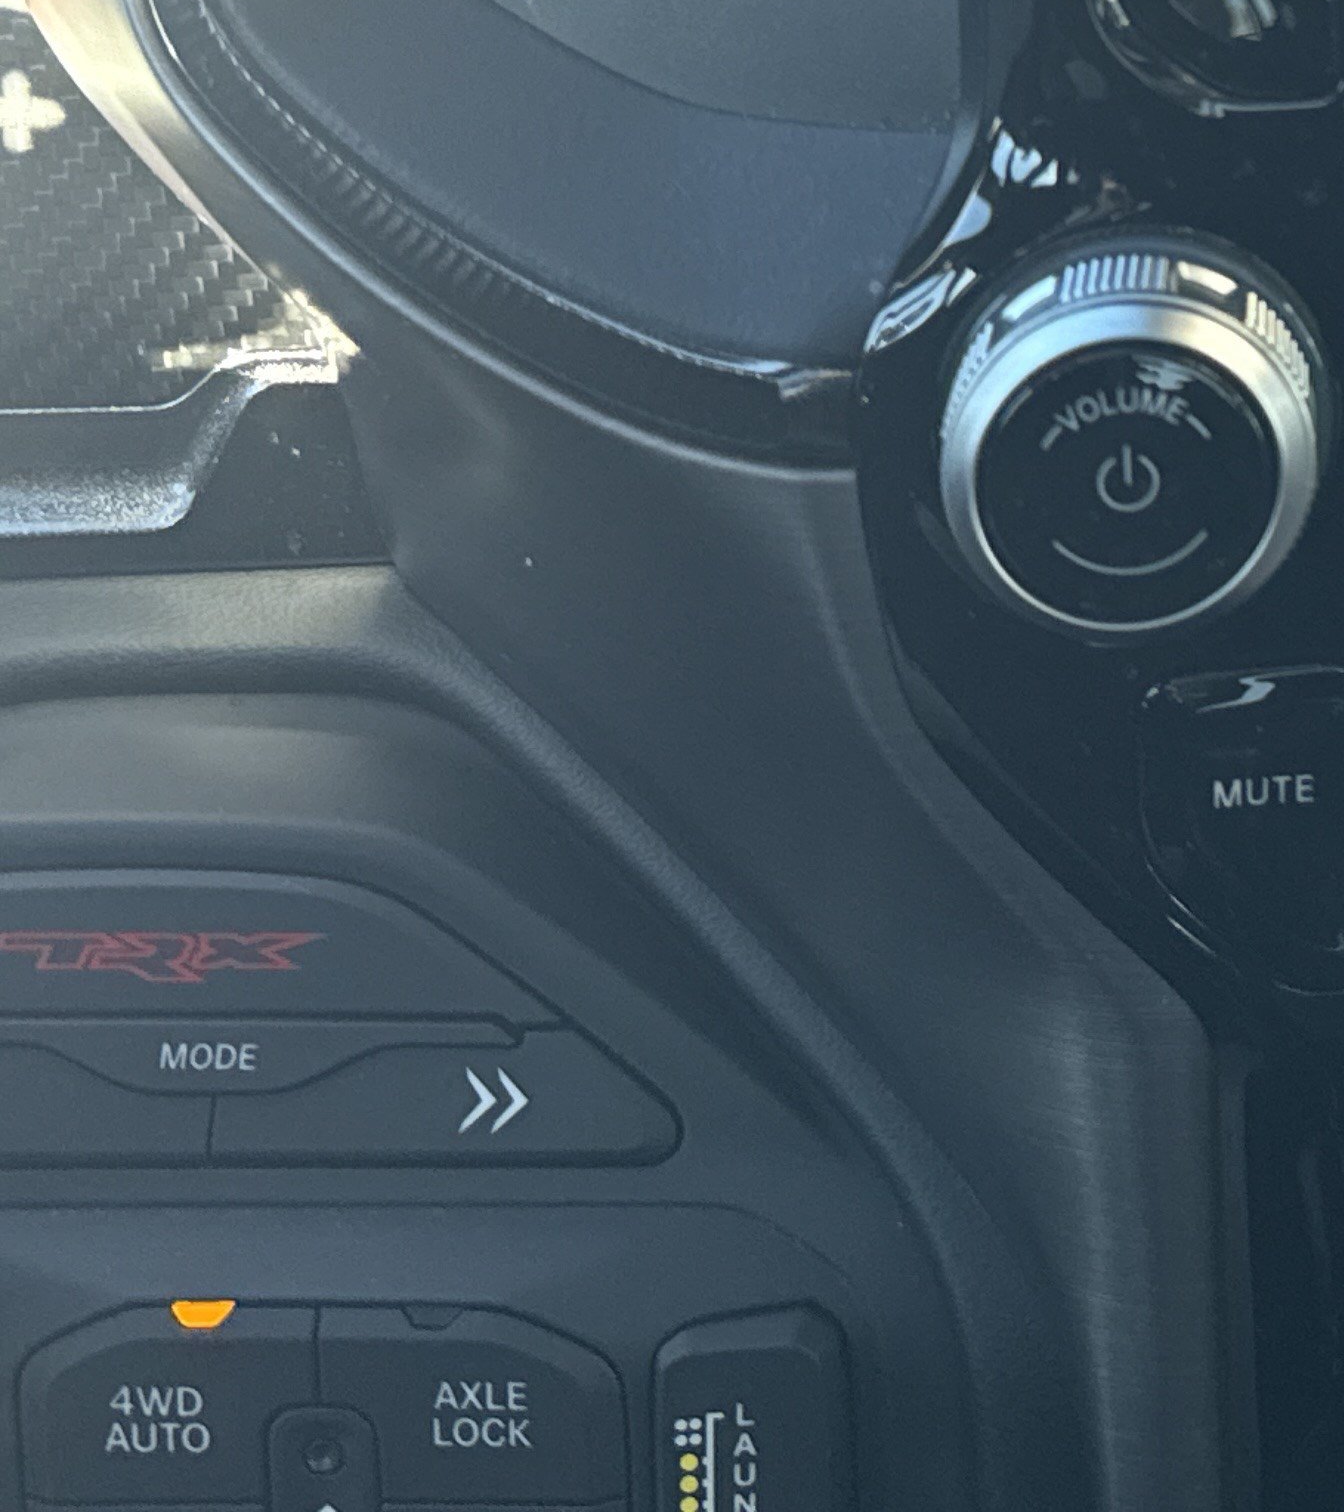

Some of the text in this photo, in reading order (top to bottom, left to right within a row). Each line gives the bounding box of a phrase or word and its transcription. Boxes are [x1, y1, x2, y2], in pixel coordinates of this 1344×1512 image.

[1052, 389, 1189, 432] VOLUME
[1213, 773, 1314, 809] MUTE
[0, 931, 326, 983] TRX
[159, 1042, 258, 1071] MODE
[109, 1385, 203, 1417] 4WD
[434, 1381, 527, 1412] AXLE
[105, 1422, 211, 1454] AUTO
[433, 1417, 532, 1448] LOCK
